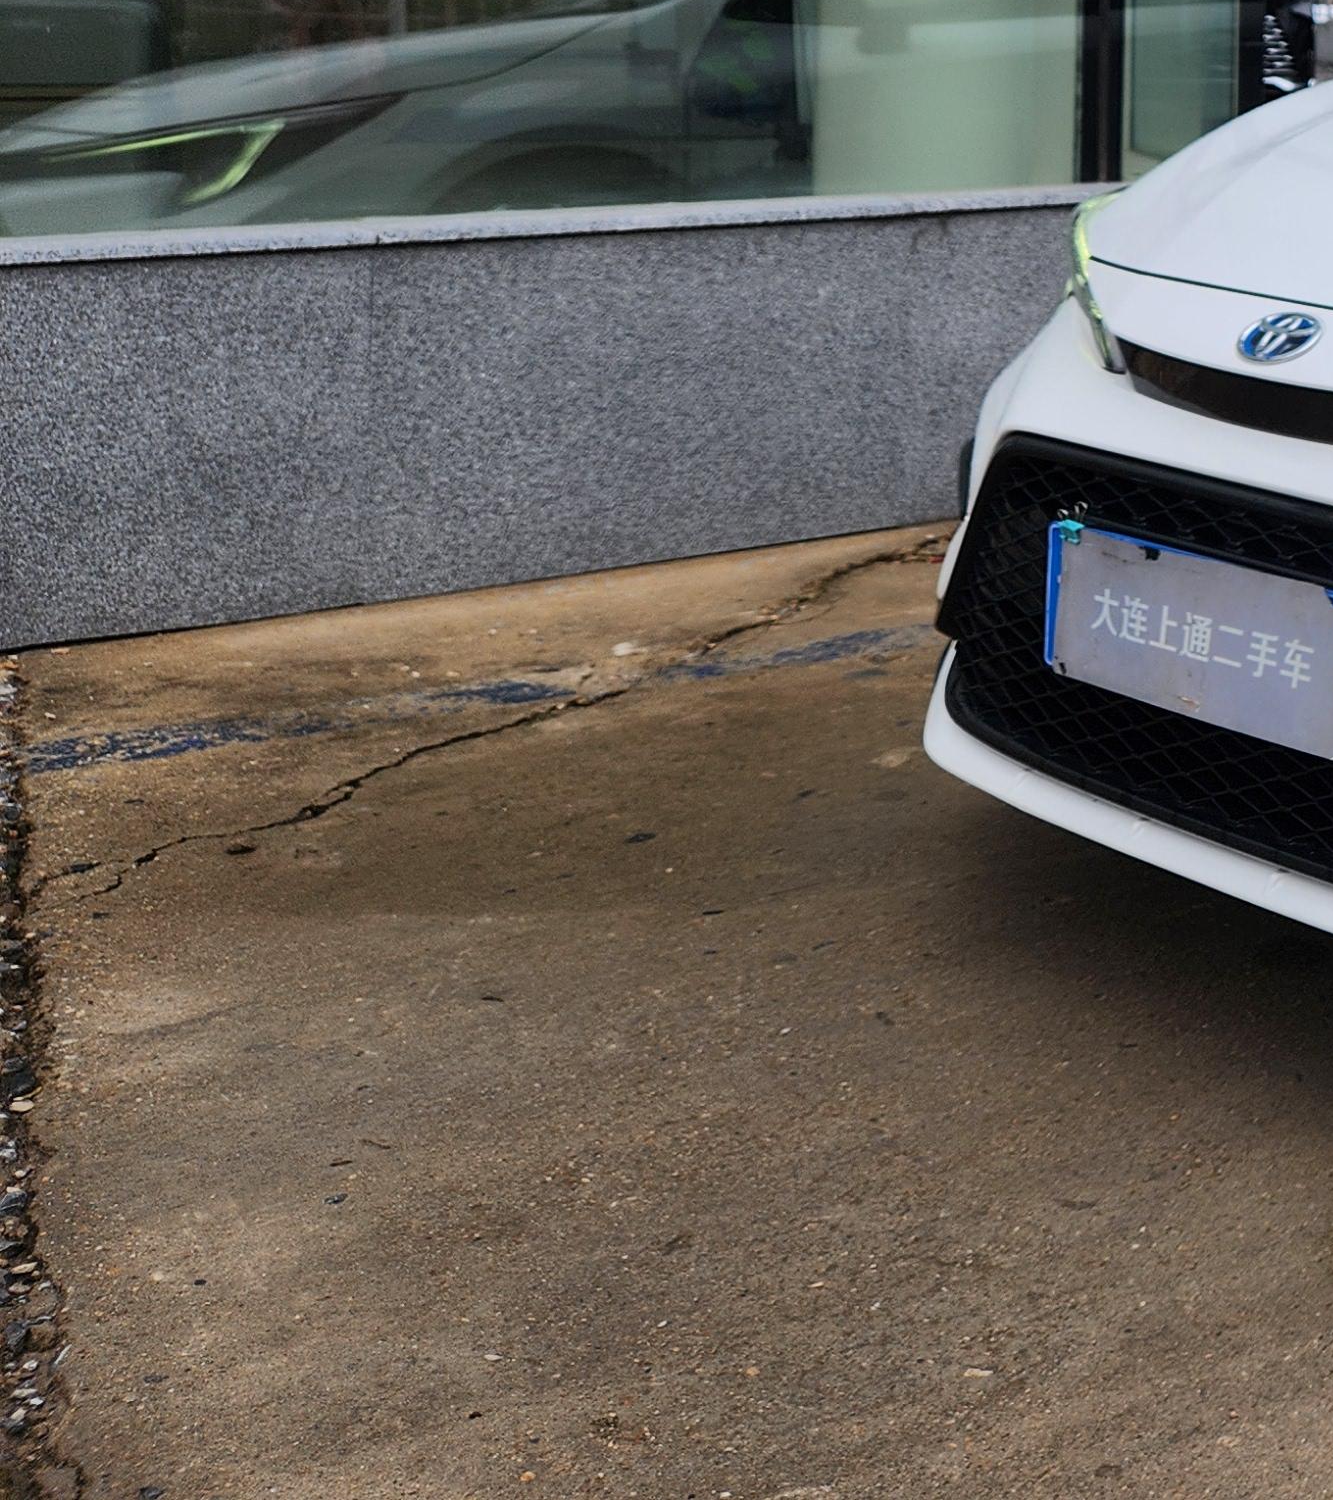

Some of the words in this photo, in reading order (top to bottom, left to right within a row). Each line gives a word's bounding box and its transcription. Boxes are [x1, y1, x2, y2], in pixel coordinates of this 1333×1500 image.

[1091, 588, 1315, 689] 大连上通二手车
